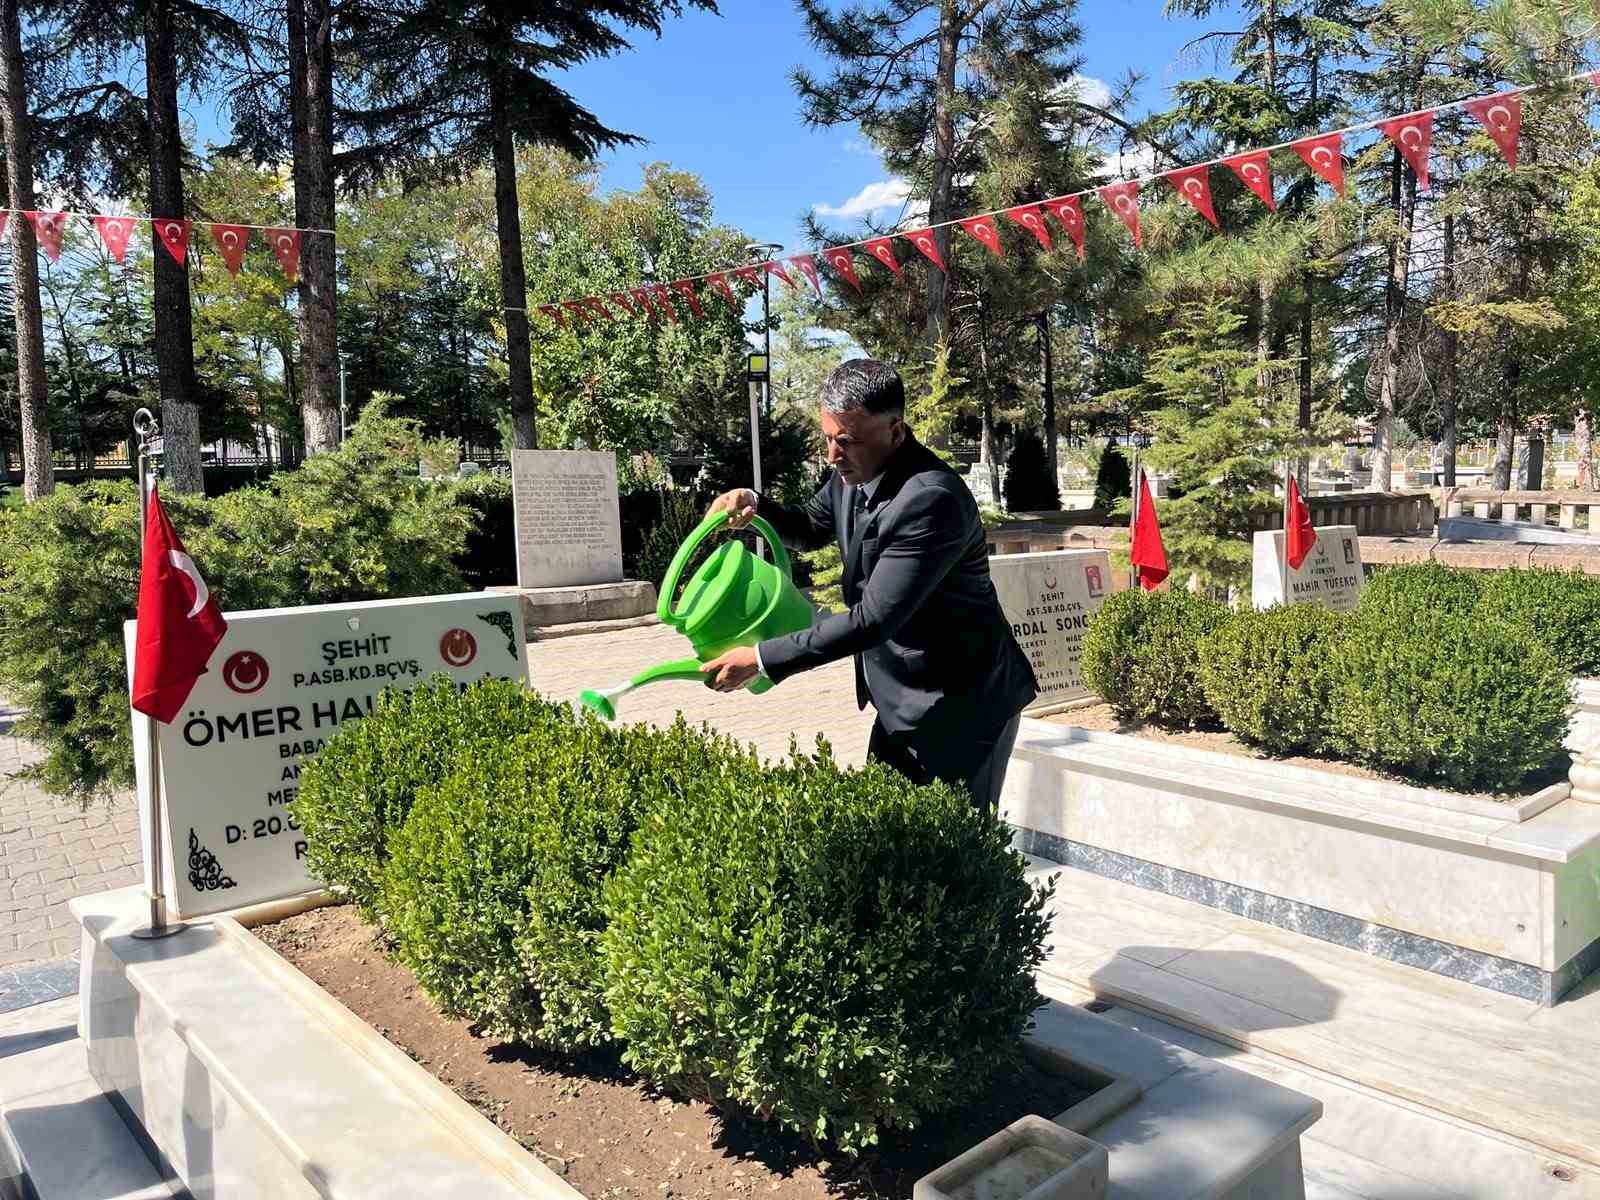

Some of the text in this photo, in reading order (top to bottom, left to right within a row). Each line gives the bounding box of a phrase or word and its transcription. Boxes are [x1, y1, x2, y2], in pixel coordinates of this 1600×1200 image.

[1013, 621, 1047, 637] RDAL
[322, 633, 391, 665] ŞEHİT
[293, 660, 423, 688] P.ASB.KD.BÇVŞ.
[183, 706, 302, 747] ÖMER
[225, 825, 247, 844] D:
